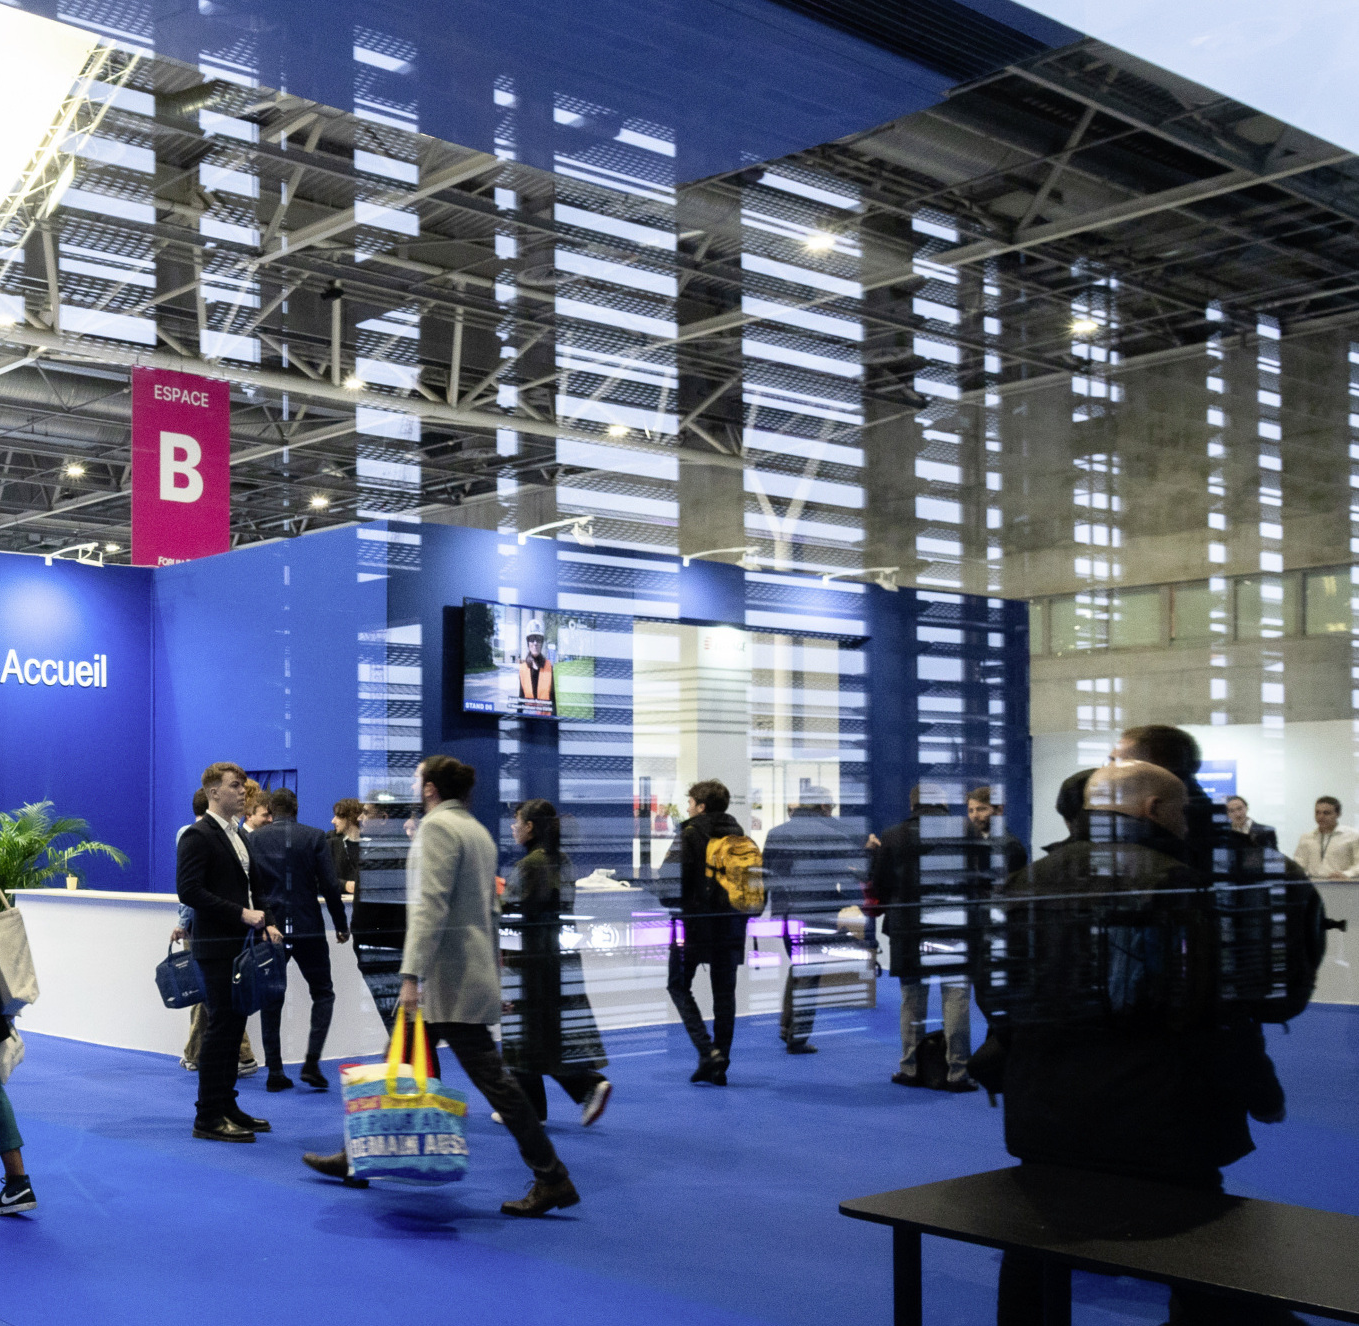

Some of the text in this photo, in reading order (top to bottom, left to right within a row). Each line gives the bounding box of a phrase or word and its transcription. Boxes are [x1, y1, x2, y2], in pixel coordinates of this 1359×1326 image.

[154, 384, 209, 407] ESPACE
[160, 431, 204, 503] B
[0, 649, 107, 688] Accueil
